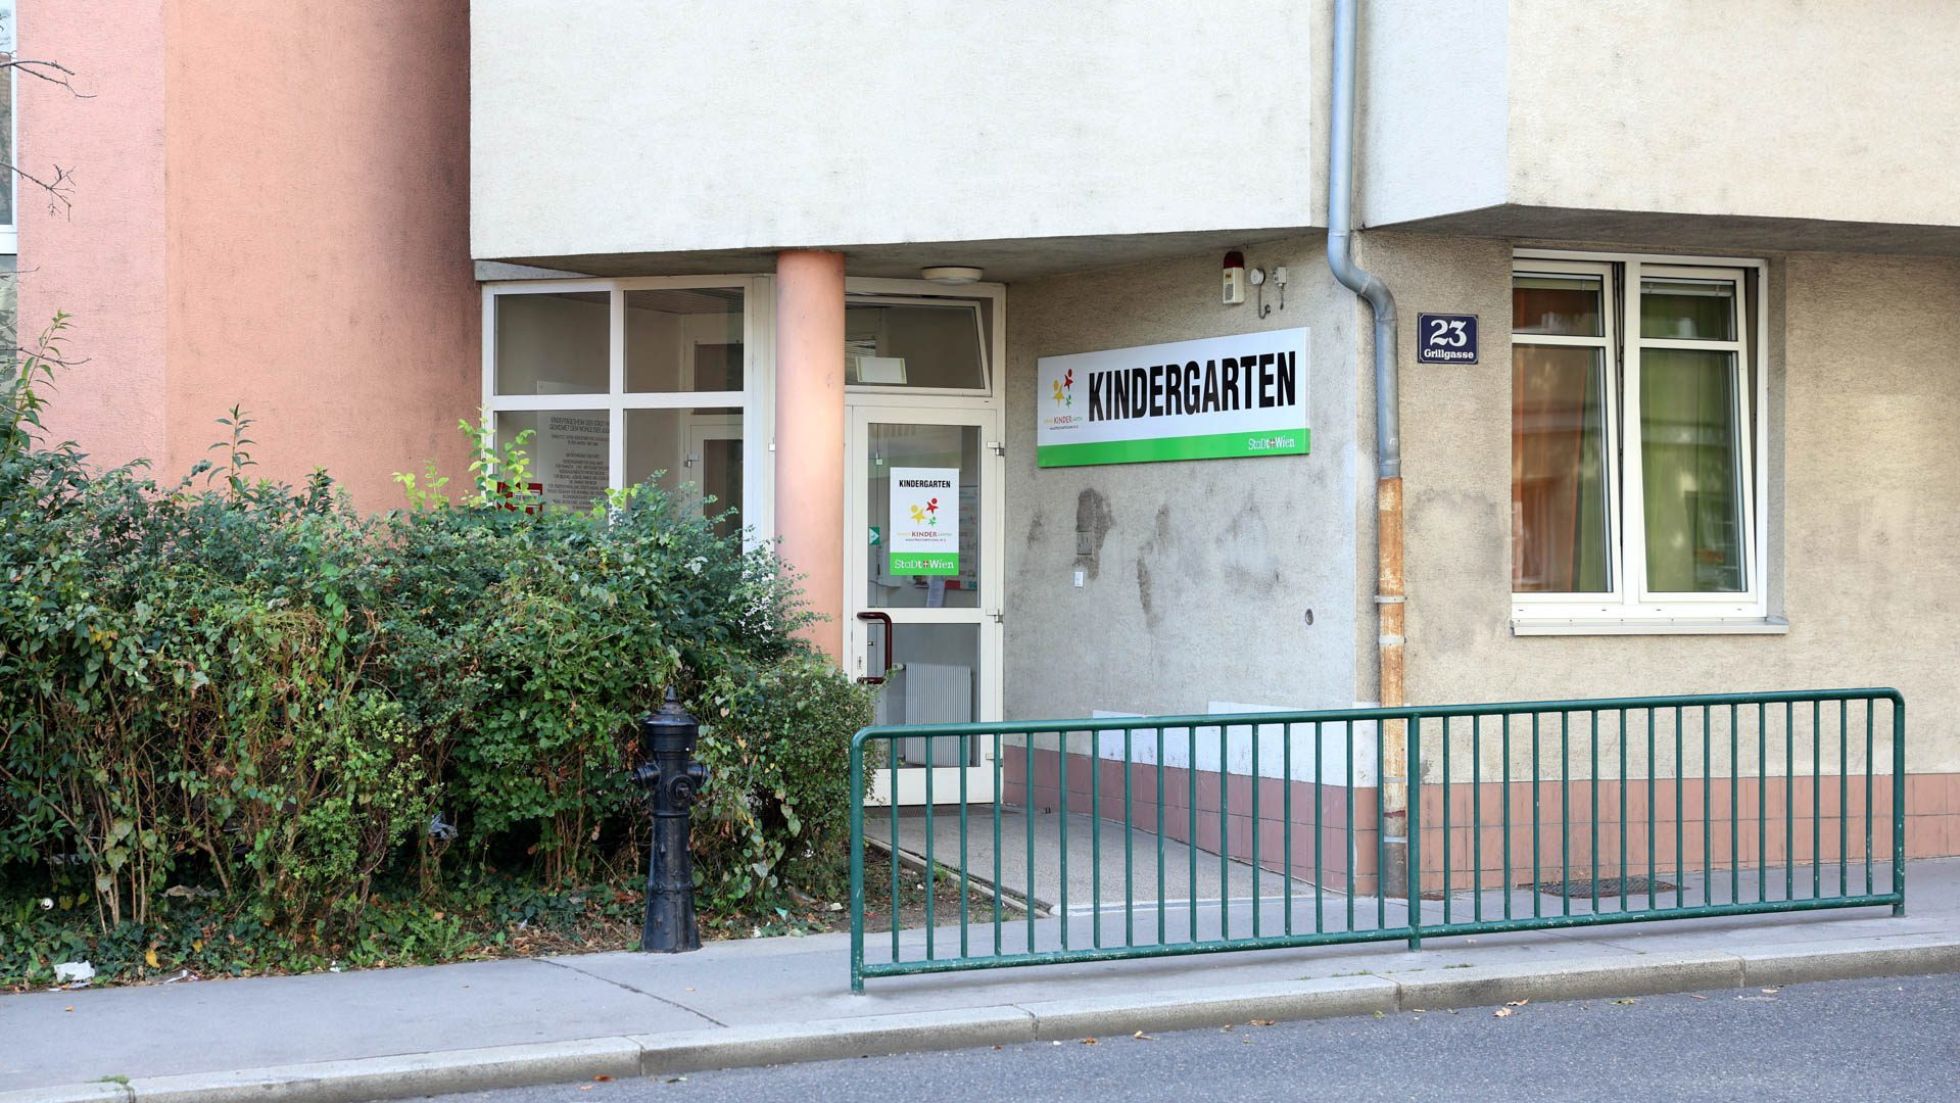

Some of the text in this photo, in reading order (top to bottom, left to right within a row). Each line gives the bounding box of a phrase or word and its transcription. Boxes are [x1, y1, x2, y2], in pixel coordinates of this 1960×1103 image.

[1430, 319, 1467, 347] 23
[1423, 348, 1474, 361] Grillgasse
[1088, 350, 1296, 422] KINDERGARTEN
[899, 480, 951, 488] KINDERGARTEN
